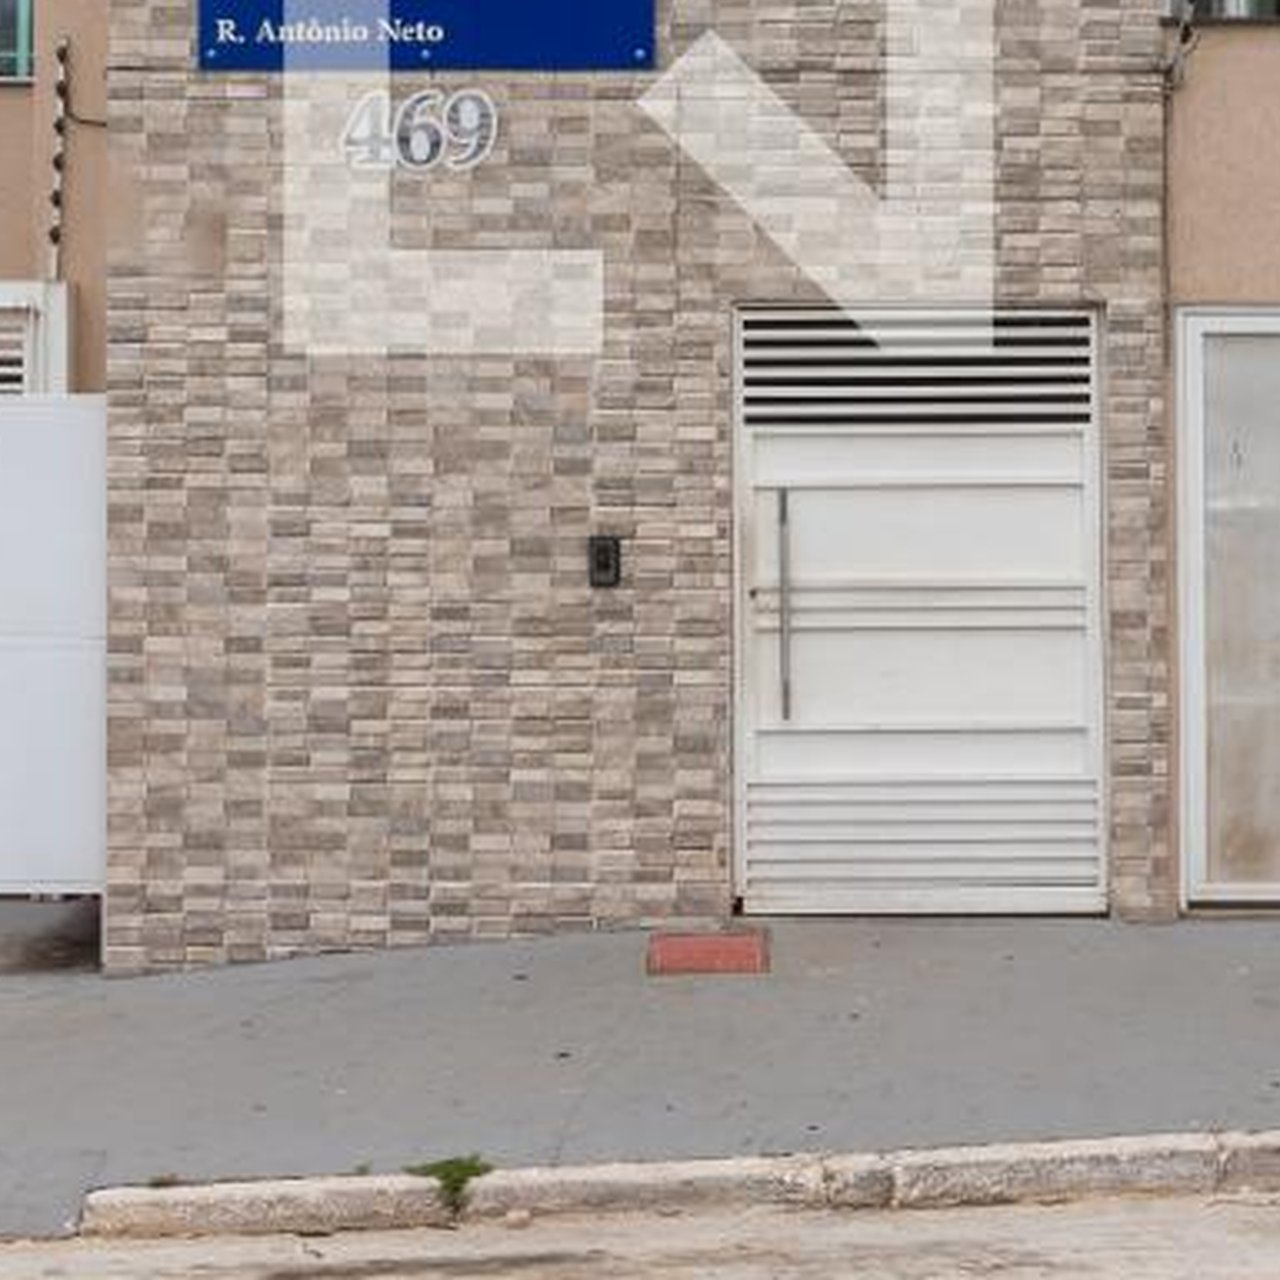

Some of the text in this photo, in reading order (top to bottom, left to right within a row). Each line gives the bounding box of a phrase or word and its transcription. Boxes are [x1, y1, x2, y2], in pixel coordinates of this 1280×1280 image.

[216, 20, 246, 43] R.
[376, 20, 444, 43] Neto
[338, 89, 498, 170] 469
